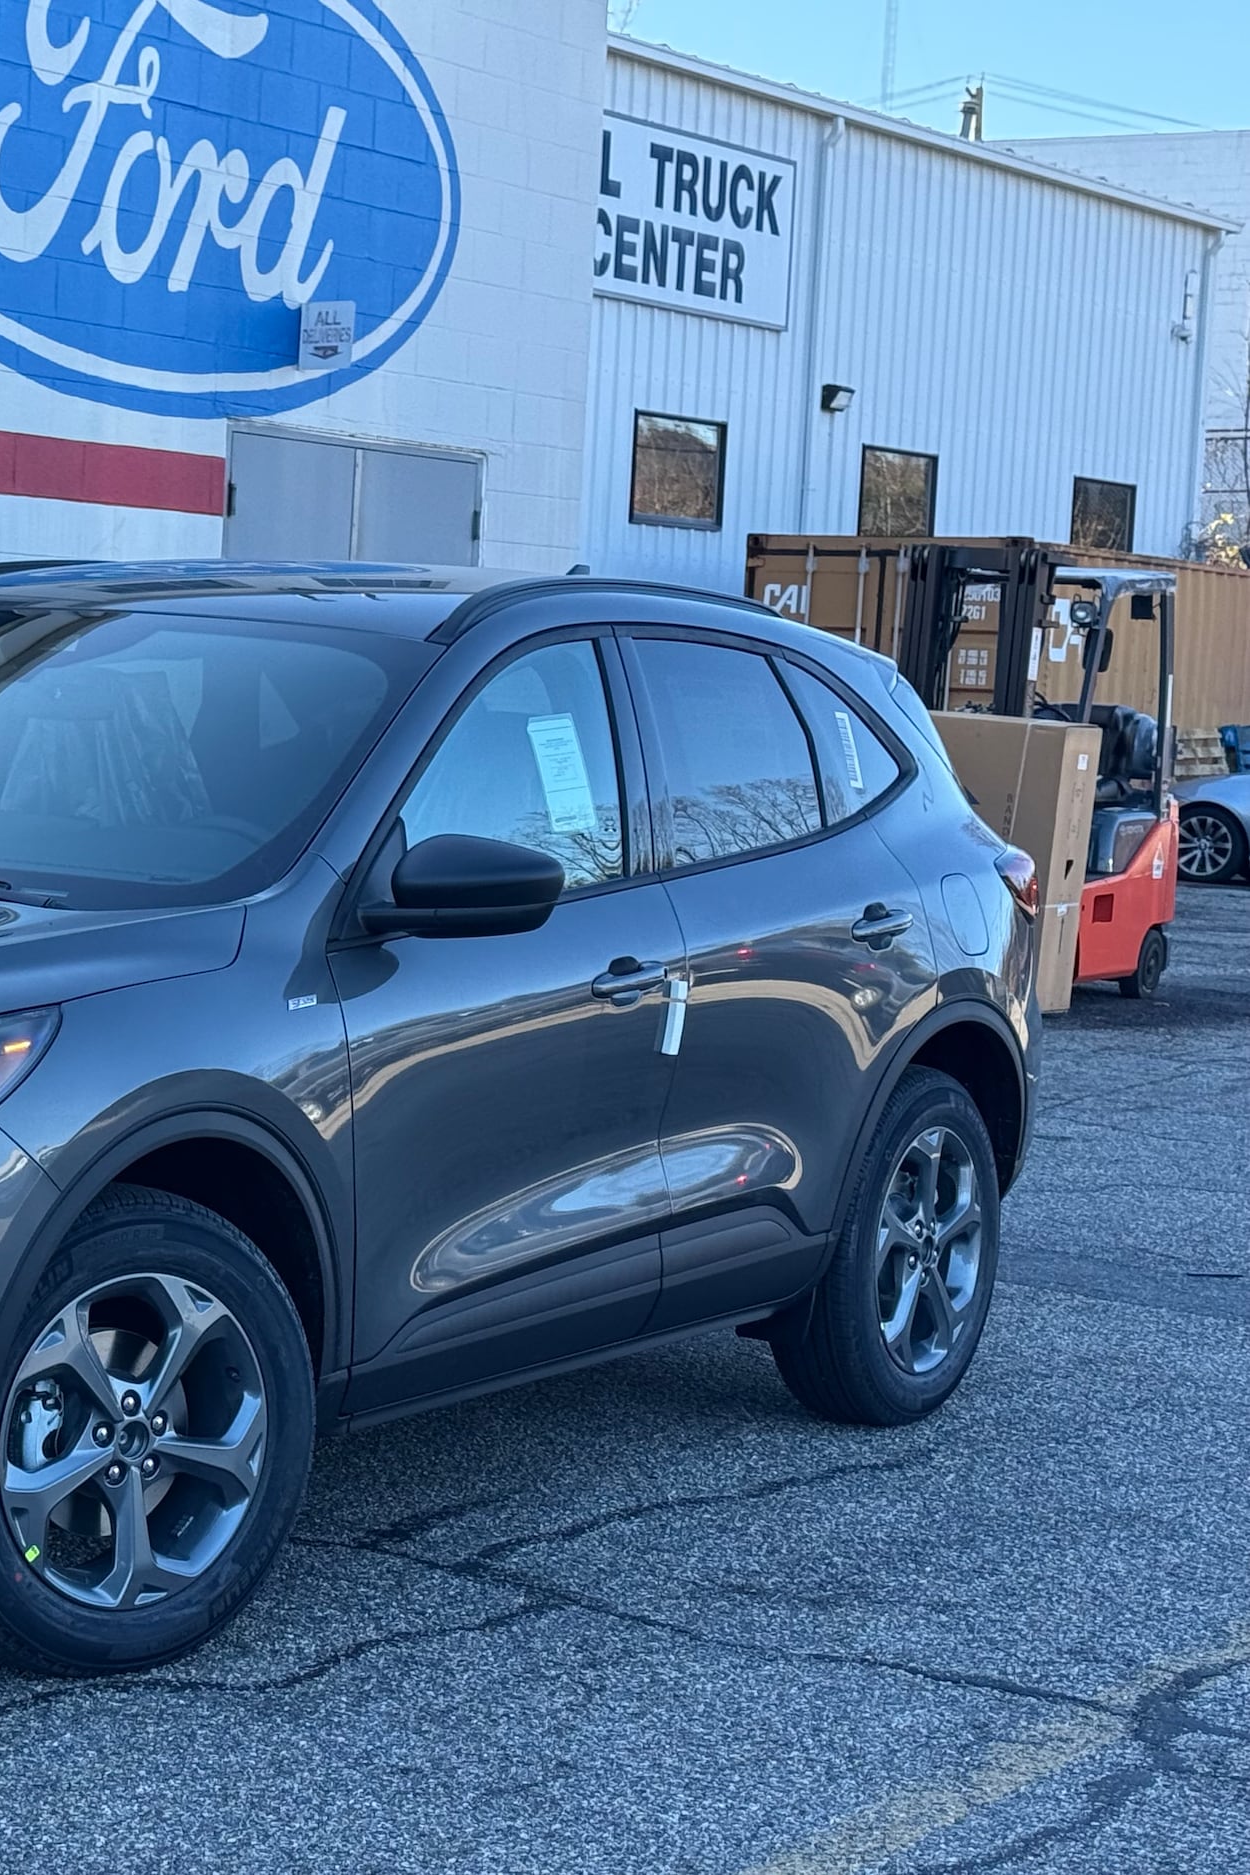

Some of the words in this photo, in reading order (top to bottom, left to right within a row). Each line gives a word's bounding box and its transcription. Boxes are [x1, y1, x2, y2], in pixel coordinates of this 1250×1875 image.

[650, 142, 783, 237] TRUCK
[593, 208, 746, 304] CENTER
[314, 310, 342, 327] ALL
